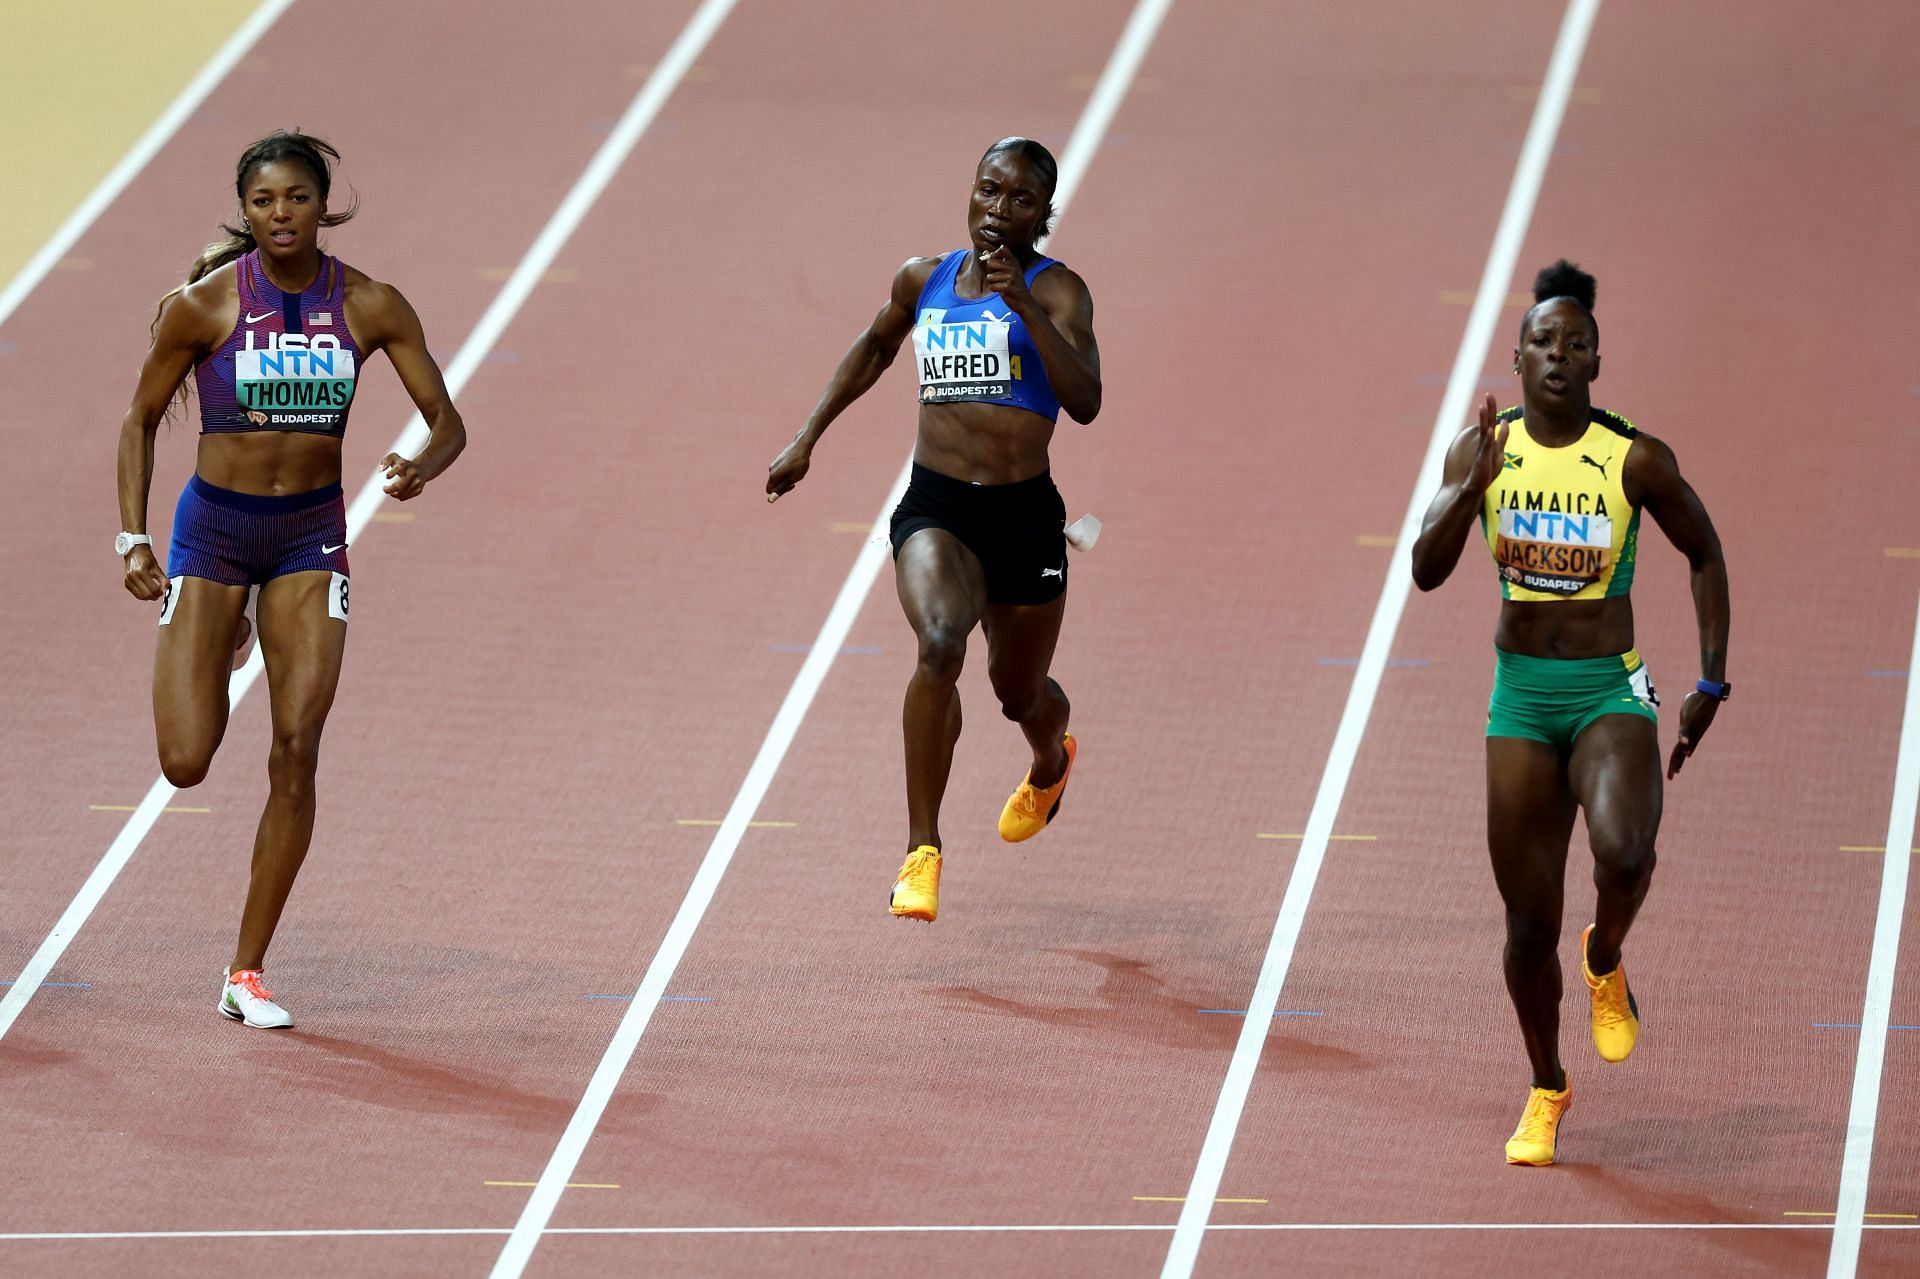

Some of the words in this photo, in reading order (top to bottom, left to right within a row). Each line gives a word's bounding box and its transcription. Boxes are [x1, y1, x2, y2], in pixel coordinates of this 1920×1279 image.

[926, 323, 988, 351] NTN
[259, 350, 334, 377] NTN
[923, 353, 1000, 380] ALFRED
[243, 381, 347, 406] THOMAS
[936, 386, 989, 397] BUDAPEST
[989, 385, 1004, 395] 23
[271, 414, 333, 424] BUDAPEST
[1496, 489, 1609, 517] JAMAICA
[1513, 511, 1589, 544] NTN
[1499, 540, 1603, 574] JACKSON
[1524, 575, 1586, 591] BUDAPEST
[339, 579, 349, 615] 8
